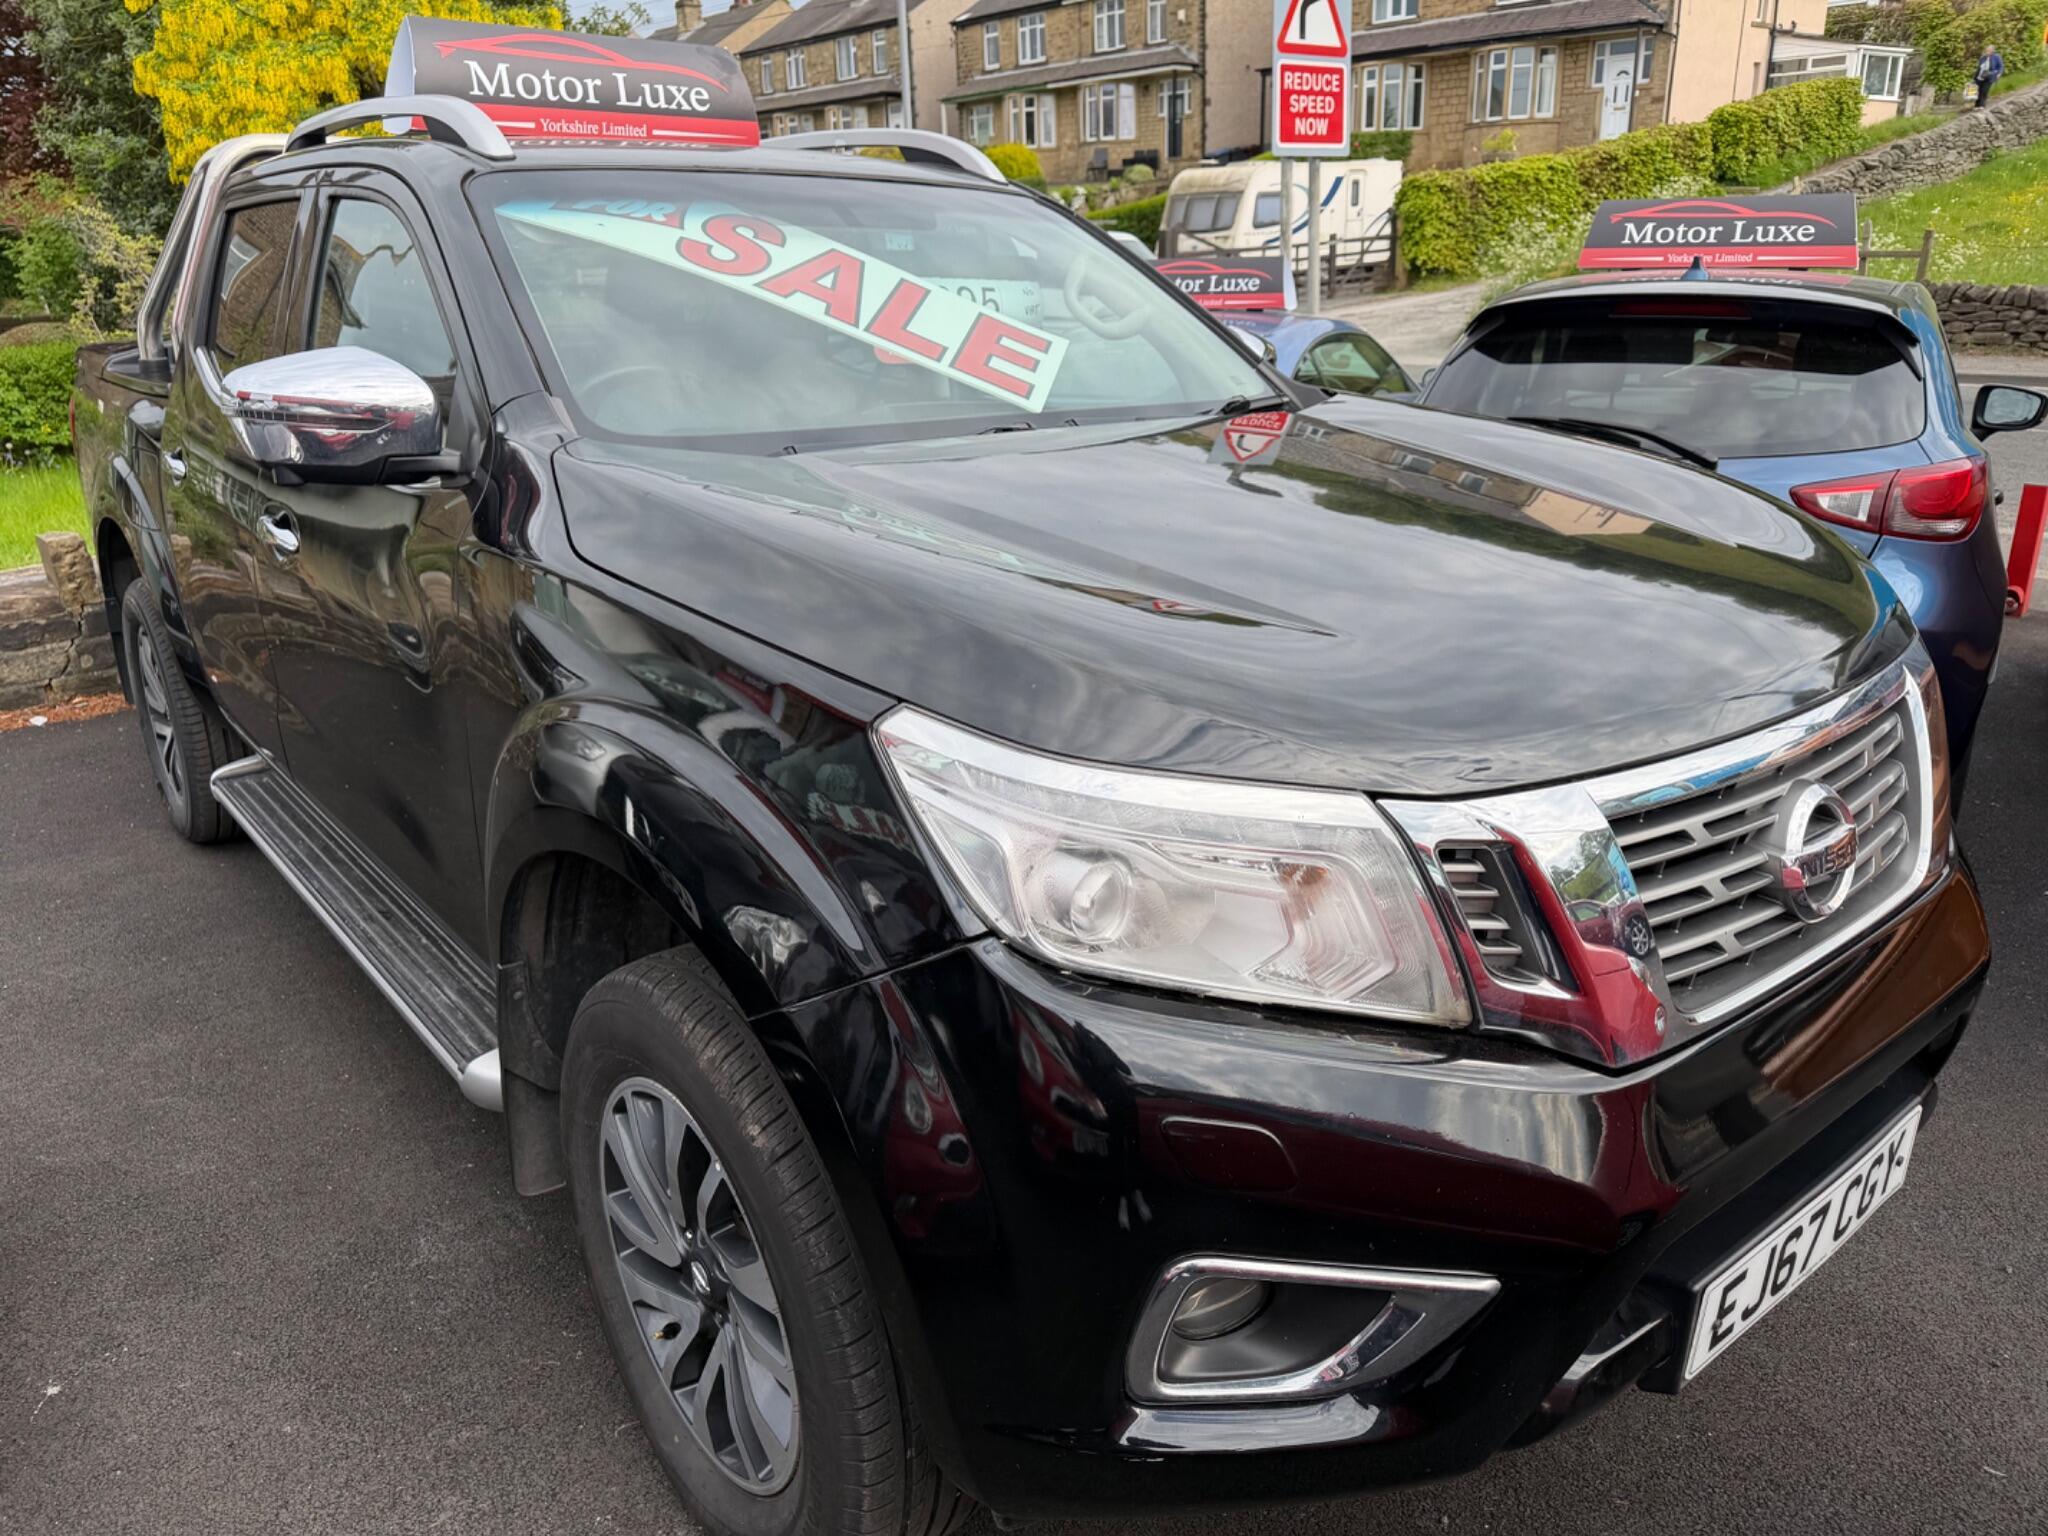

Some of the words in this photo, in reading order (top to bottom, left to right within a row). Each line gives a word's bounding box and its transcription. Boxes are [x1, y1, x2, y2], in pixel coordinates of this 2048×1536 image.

[463, 60, 602, 105] Motor
[612, 72, 711, 112] Luxe
[1283, 71, 1340, 92] REDUCE
[1289, 95, 1335, 114] SPEED
[540, 117, 599, 135] Yorkshire
[602, 121, 648, 137] Limited
[1295, 117, 1329, 136] NOW
[1621, 221, 1723, 245] Motor
[1733, 220, 1816, 243] Luxe
[1667, 253, 1713, 264] Yorksre
[1714, 252, 1753, 263] Limited
[1174, 276, 1204, 293] tor
[1208, 275, 1261, 293] Luxe
[676, 213, 1051, 400] SALE
[1708, 1200, 1832, 1351] EJ67
